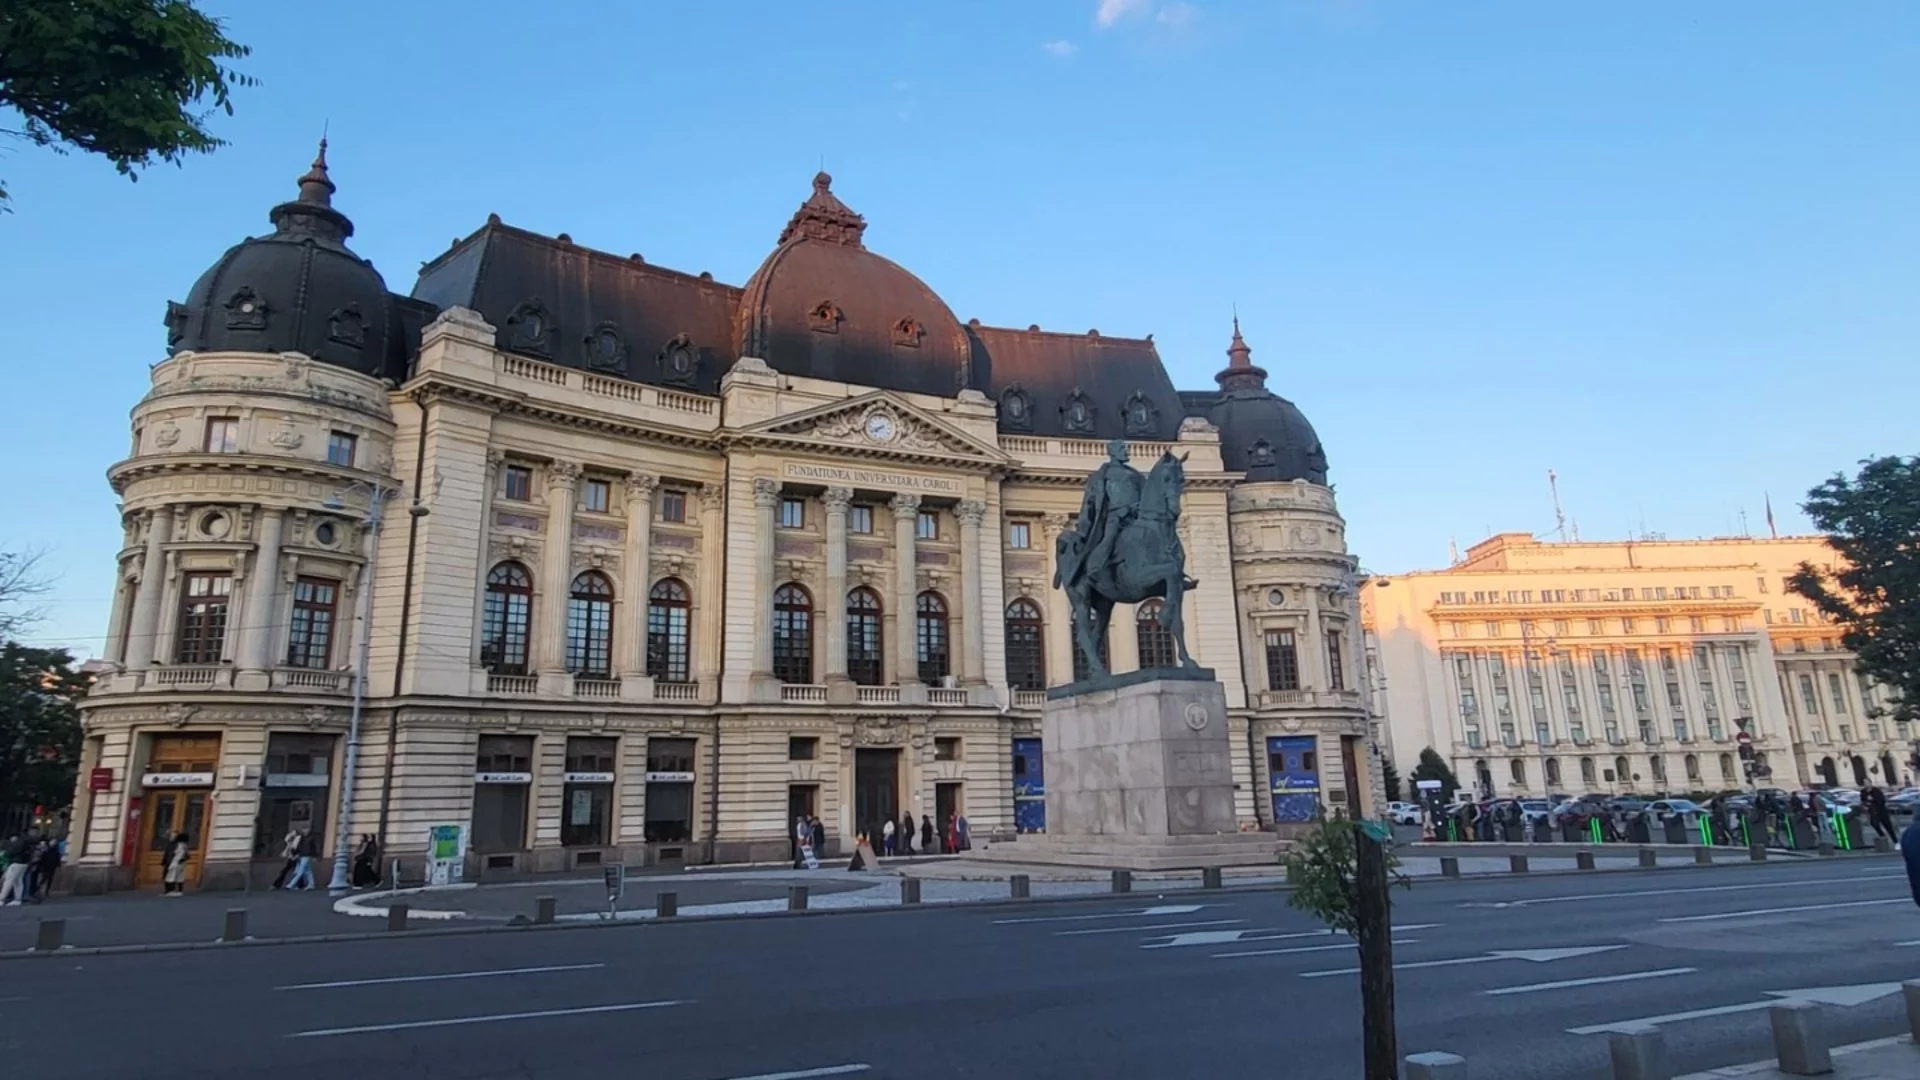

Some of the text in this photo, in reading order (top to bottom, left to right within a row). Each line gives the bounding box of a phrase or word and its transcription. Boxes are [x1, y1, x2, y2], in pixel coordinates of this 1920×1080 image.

[787, 464, 851, 480] FUNDATIUNEA
[854, 471, 920, 487] UNIVERSITARA
[922, 478, 952, 490] CAROL
